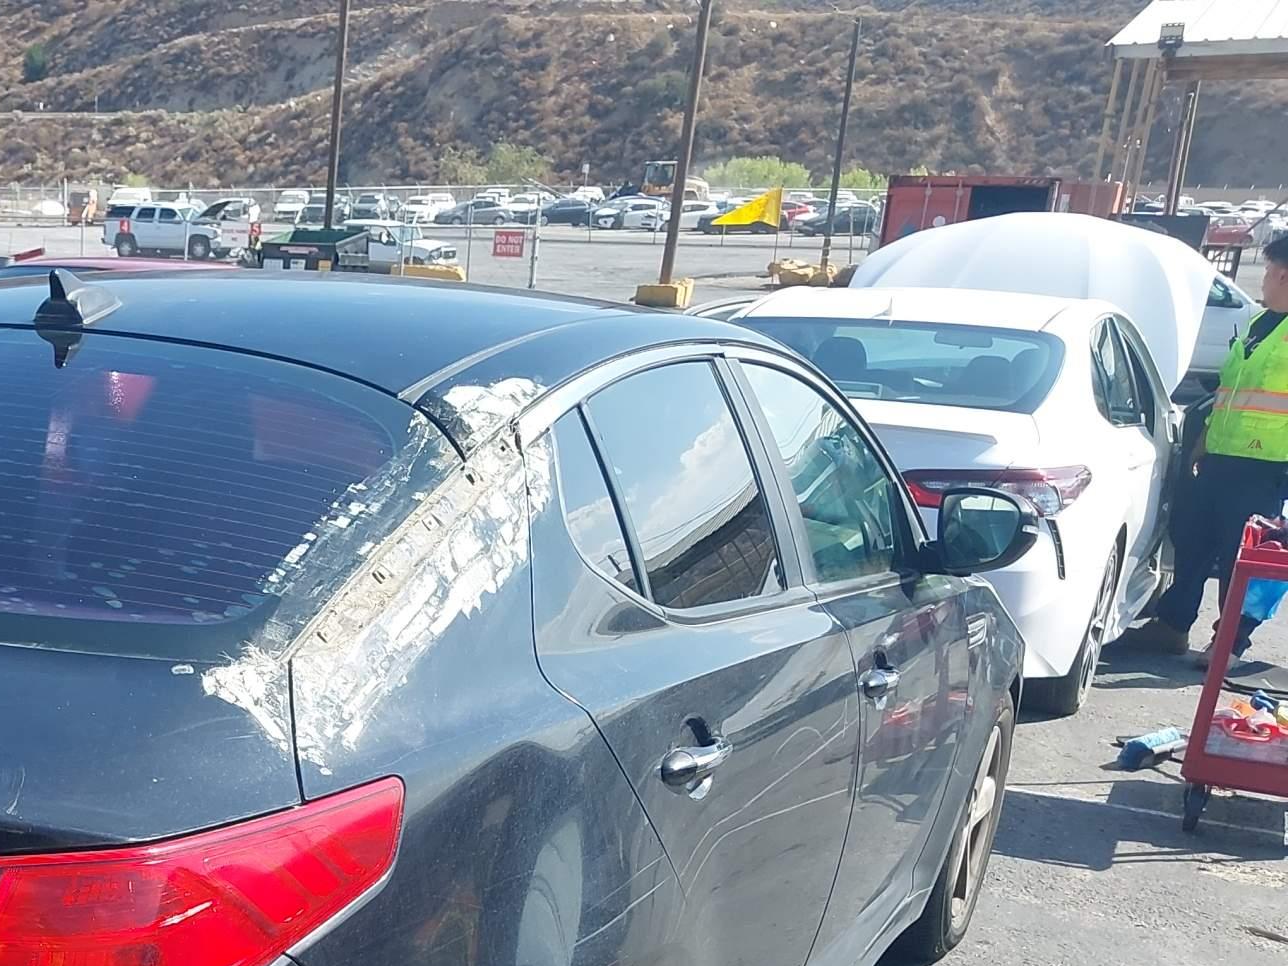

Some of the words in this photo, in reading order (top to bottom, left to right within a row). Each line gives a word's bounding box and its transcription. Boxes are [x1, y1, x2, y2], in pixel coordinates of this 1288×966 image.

[121, 220, 128, 232] 4
[495, 235, 507, 244] DO
[508, 235, 523, 244] NOT
[496, 244, 521, 254] ENTER
